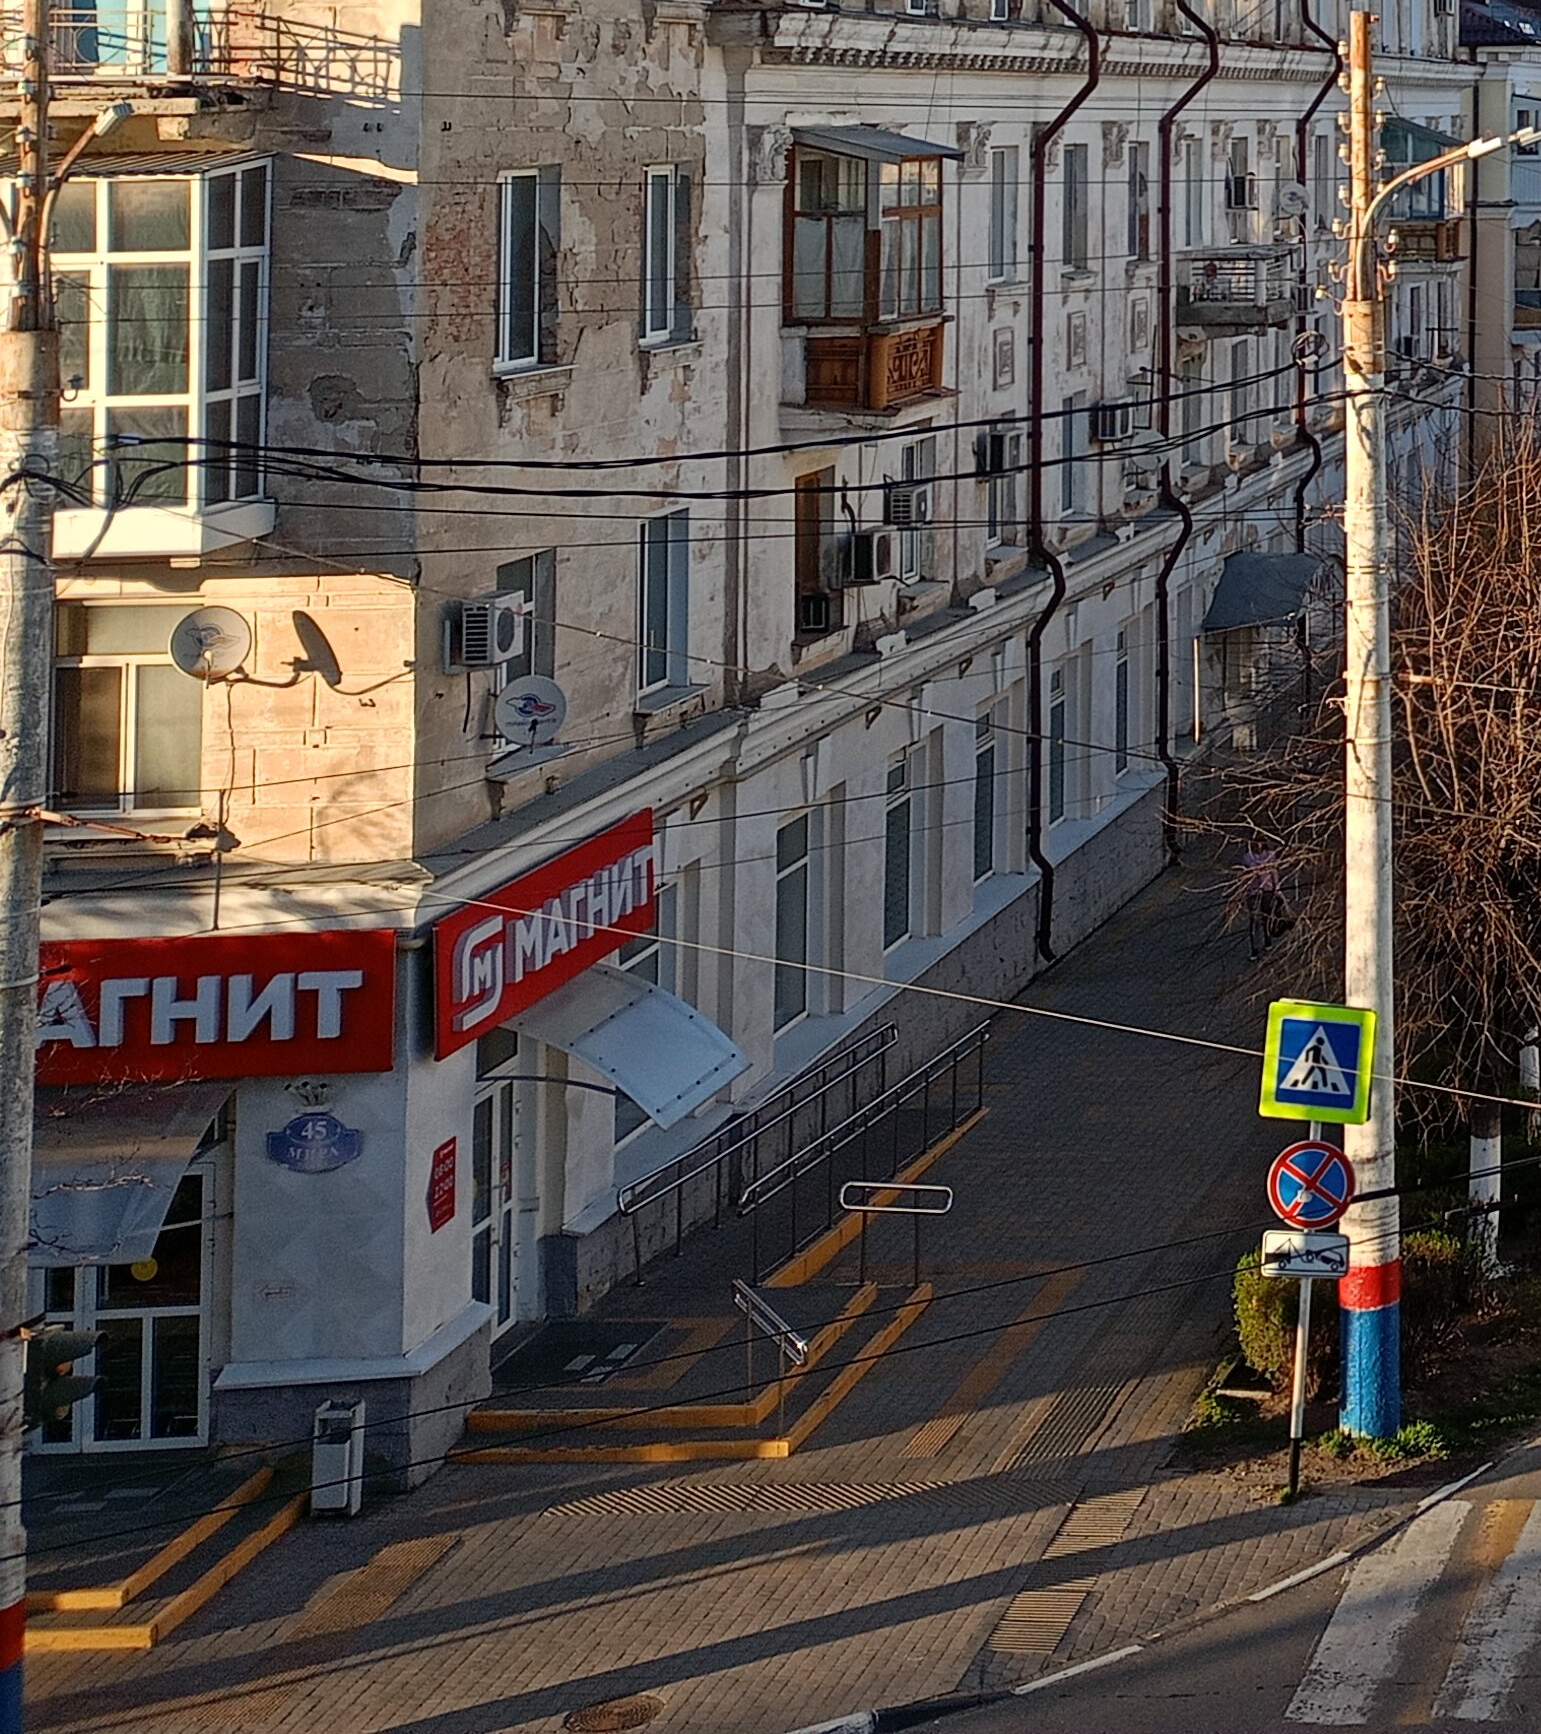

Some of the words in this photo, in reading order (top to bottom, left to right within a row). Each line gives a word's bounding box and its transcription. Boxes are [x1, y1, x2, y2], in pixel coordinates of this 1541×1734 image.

[507, 844, 654, 984] МАГНИТ
[35, 969, 364, 1049] АГНИТ
[287, 1146, 339, 1161] МИРА
[301, 1121, 327, 1140] 45
